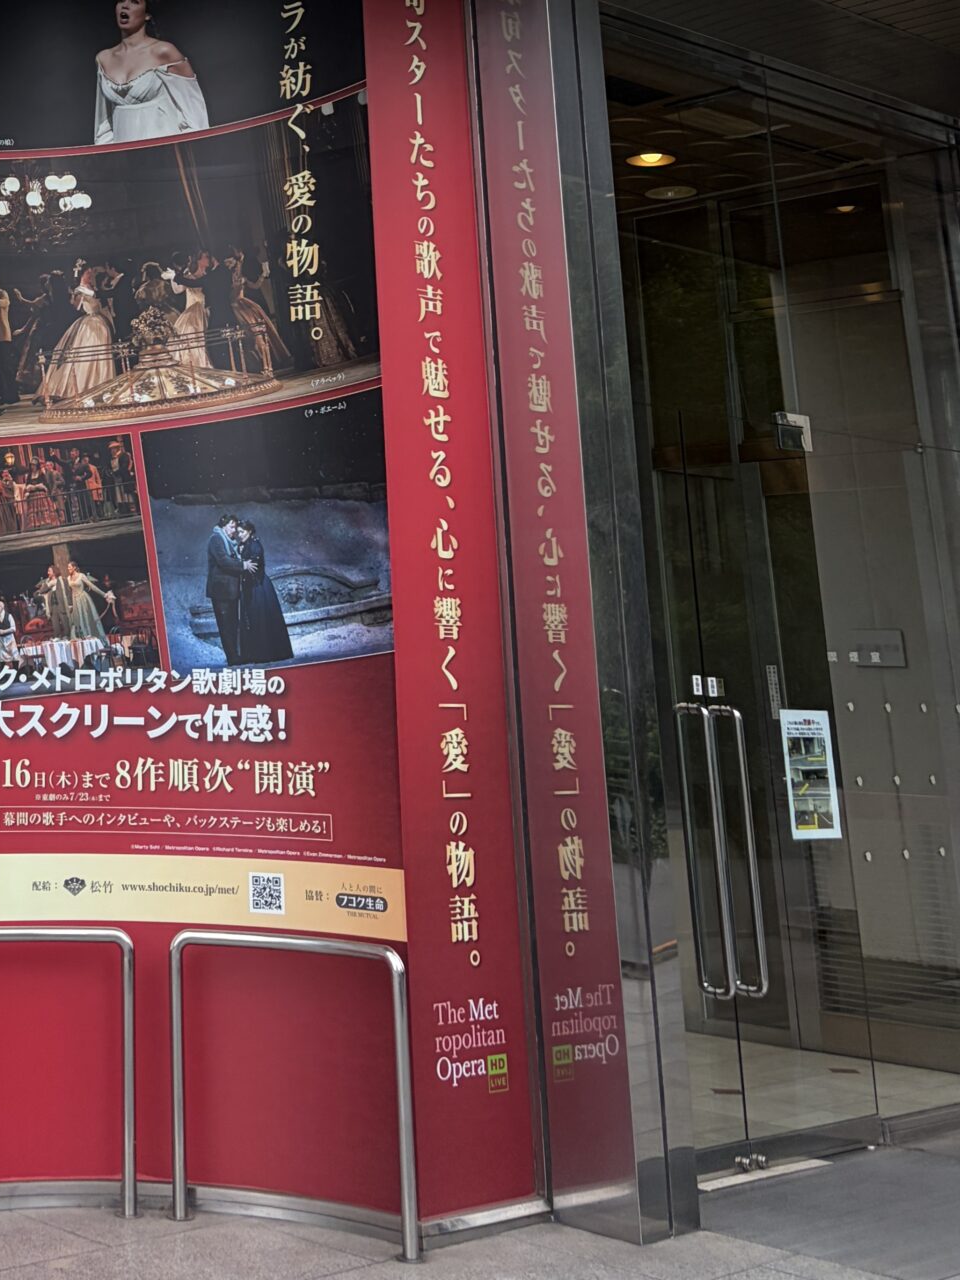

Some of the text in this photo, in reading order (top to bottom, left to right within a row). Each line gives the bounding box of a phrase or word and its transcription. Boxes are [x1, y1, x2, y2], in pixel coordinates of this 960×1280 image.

[90, 880, 114, 894] 松竹
[121, 881, 240, 897] www.shochiku.co.jp/met/
[339, 895, 384, 910] フコク生命
[433, 998, 499, 1026] The Met
[435, 1024, 506, 1058] ropolitan
[436, 1056, 486, 1086] Opera
